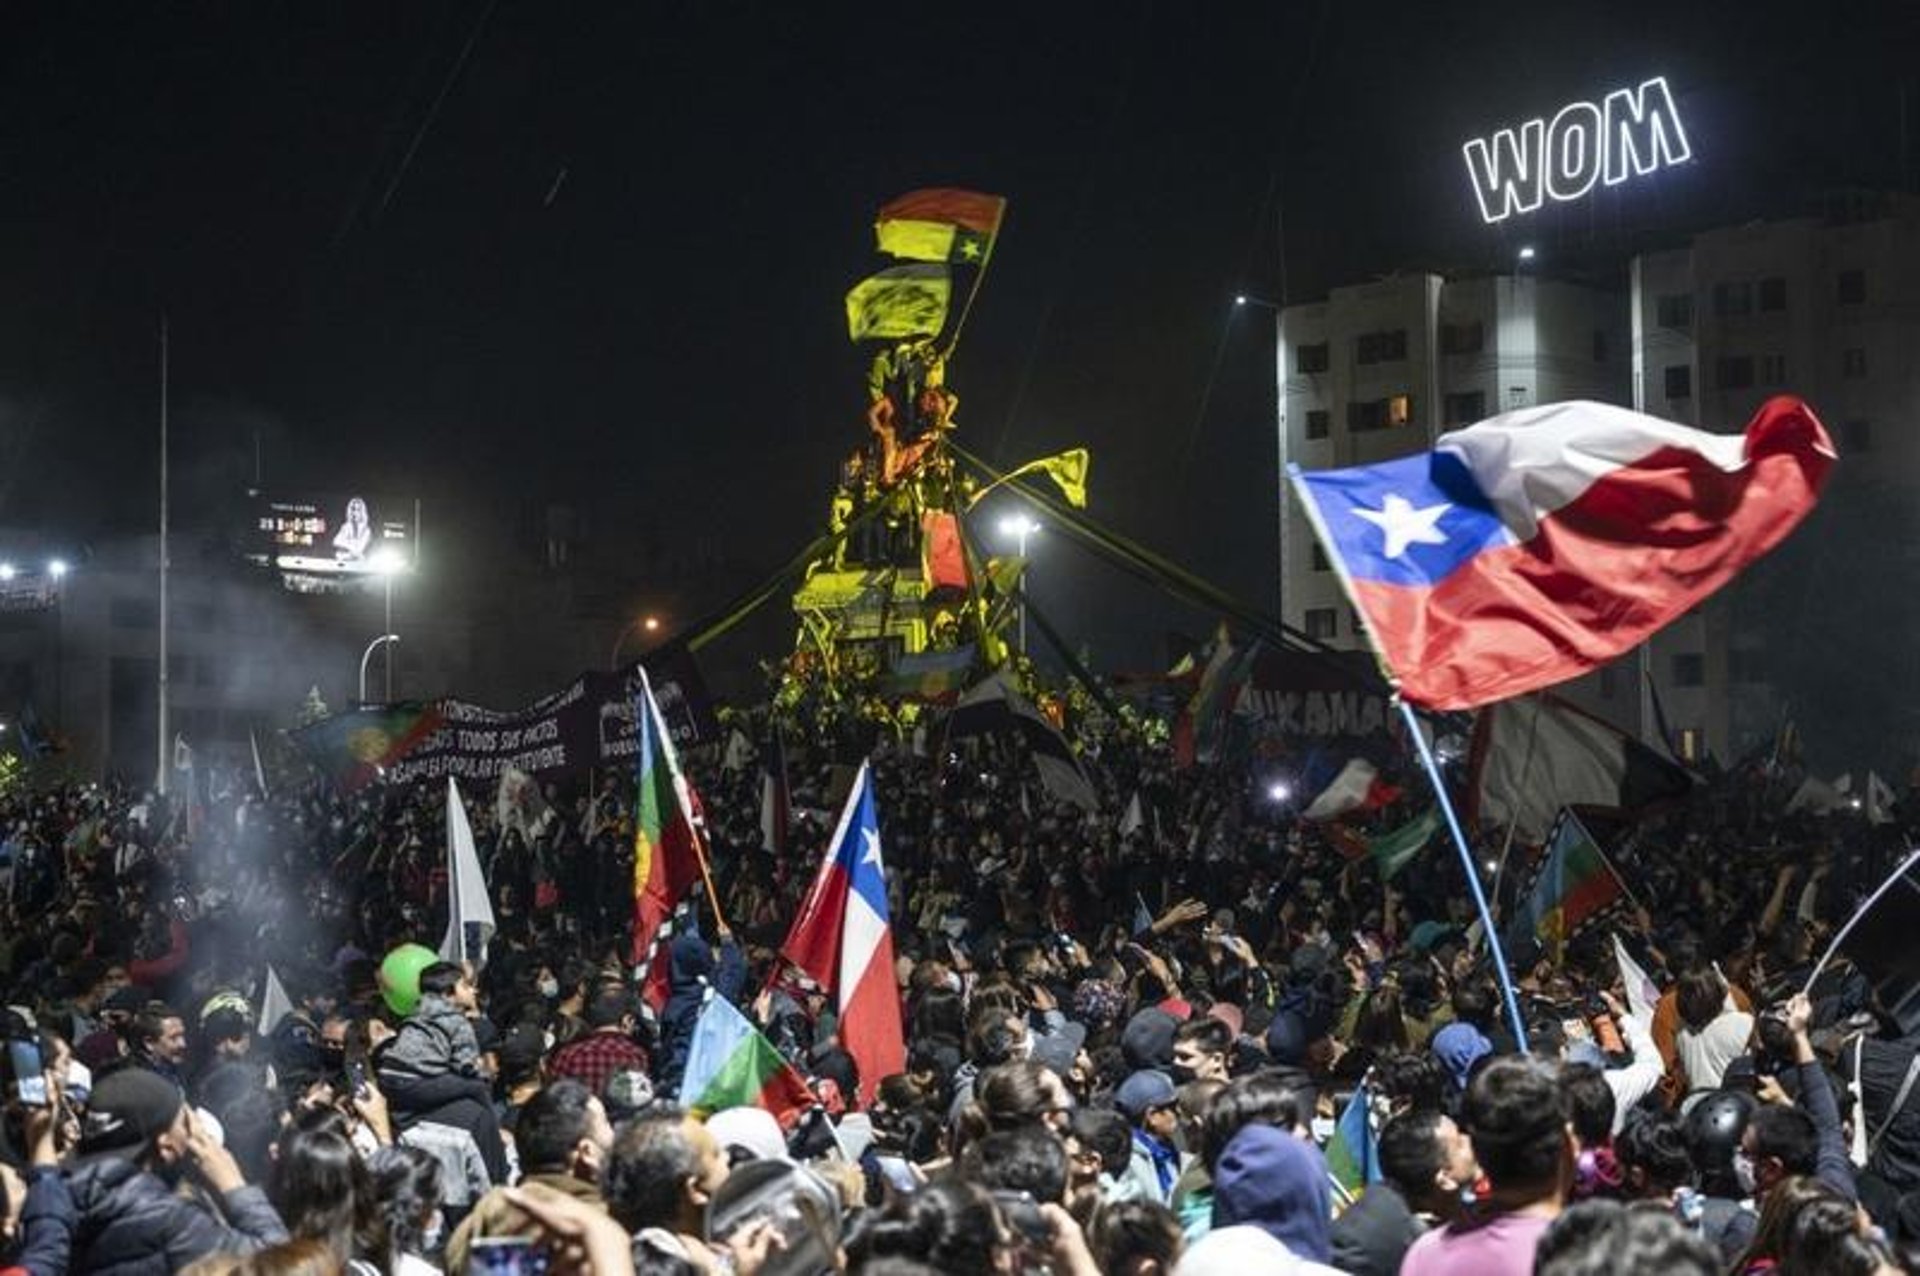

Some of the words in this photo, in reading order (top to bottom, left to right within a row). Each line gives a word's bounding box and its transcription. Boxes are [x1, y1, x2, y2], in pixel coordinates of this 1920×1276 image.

[1463, 76, 1691, 224] WOM
[458, 729, 499, 751] TODOS
[500, 727, 522, 750] SUS
